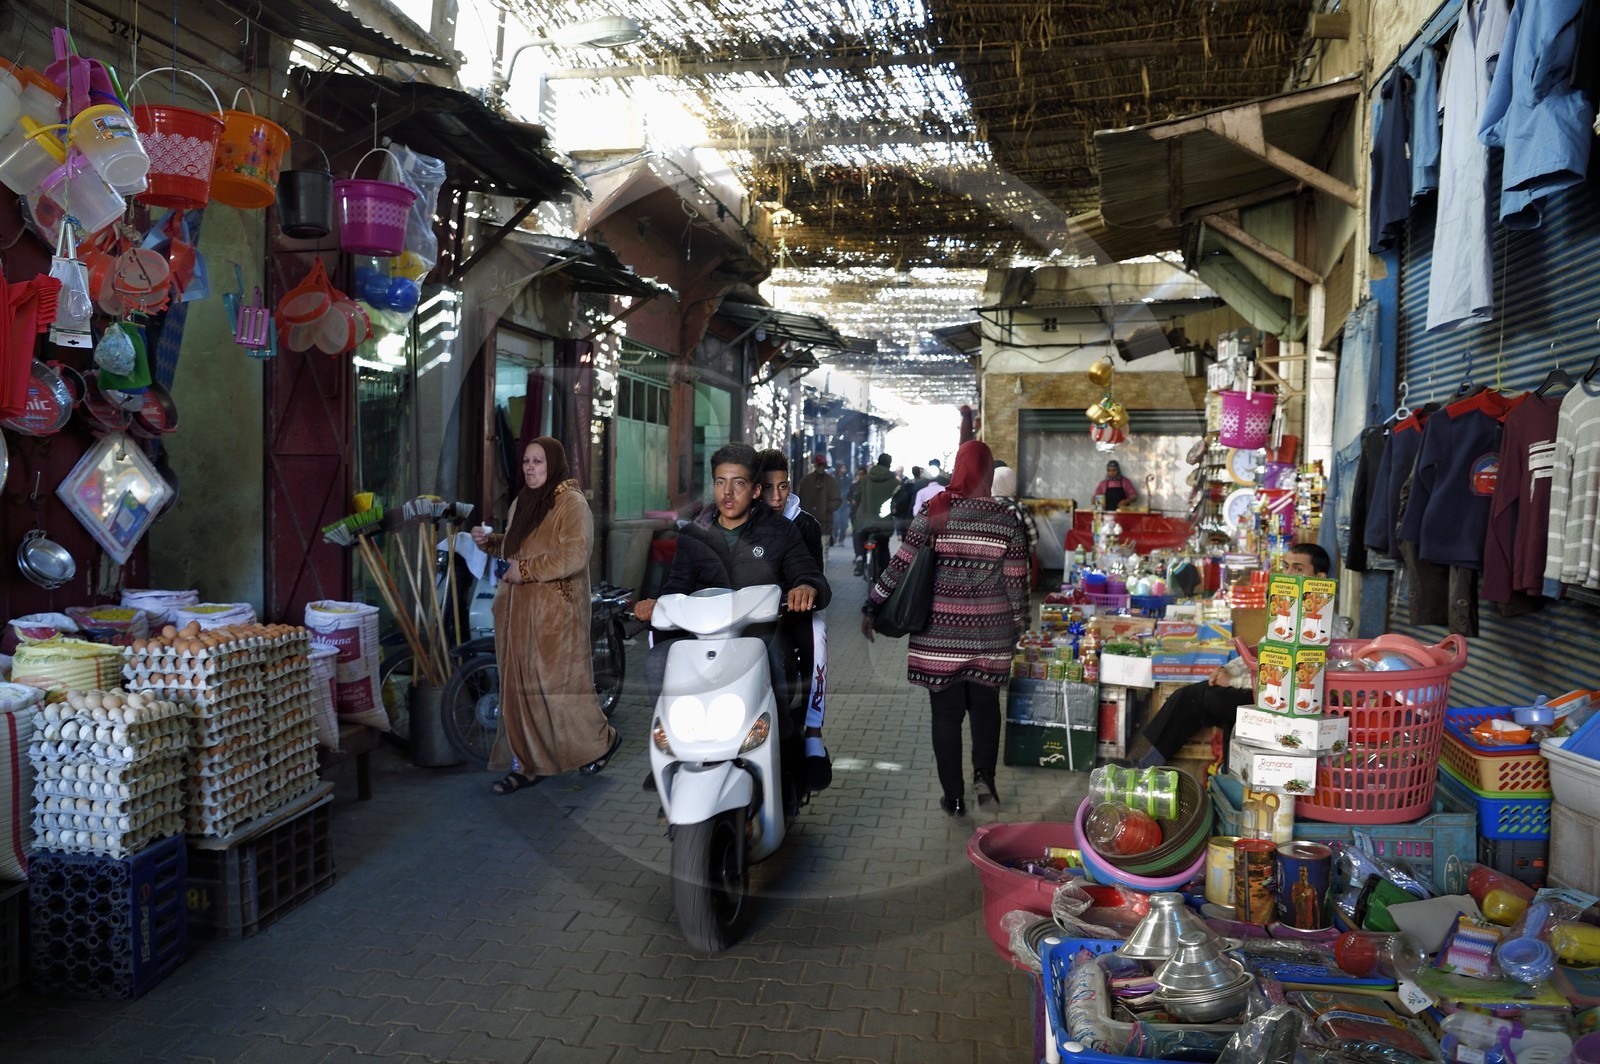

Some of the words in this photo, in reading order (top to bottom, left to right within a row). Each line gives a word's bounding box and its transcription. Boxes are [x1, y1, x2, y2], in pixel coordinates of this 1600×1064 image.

[1242, 711, 1273, 725] Romance
[1258, 758, 1293, 770] Romance
[140, 904, 151, 964] PEPSI
